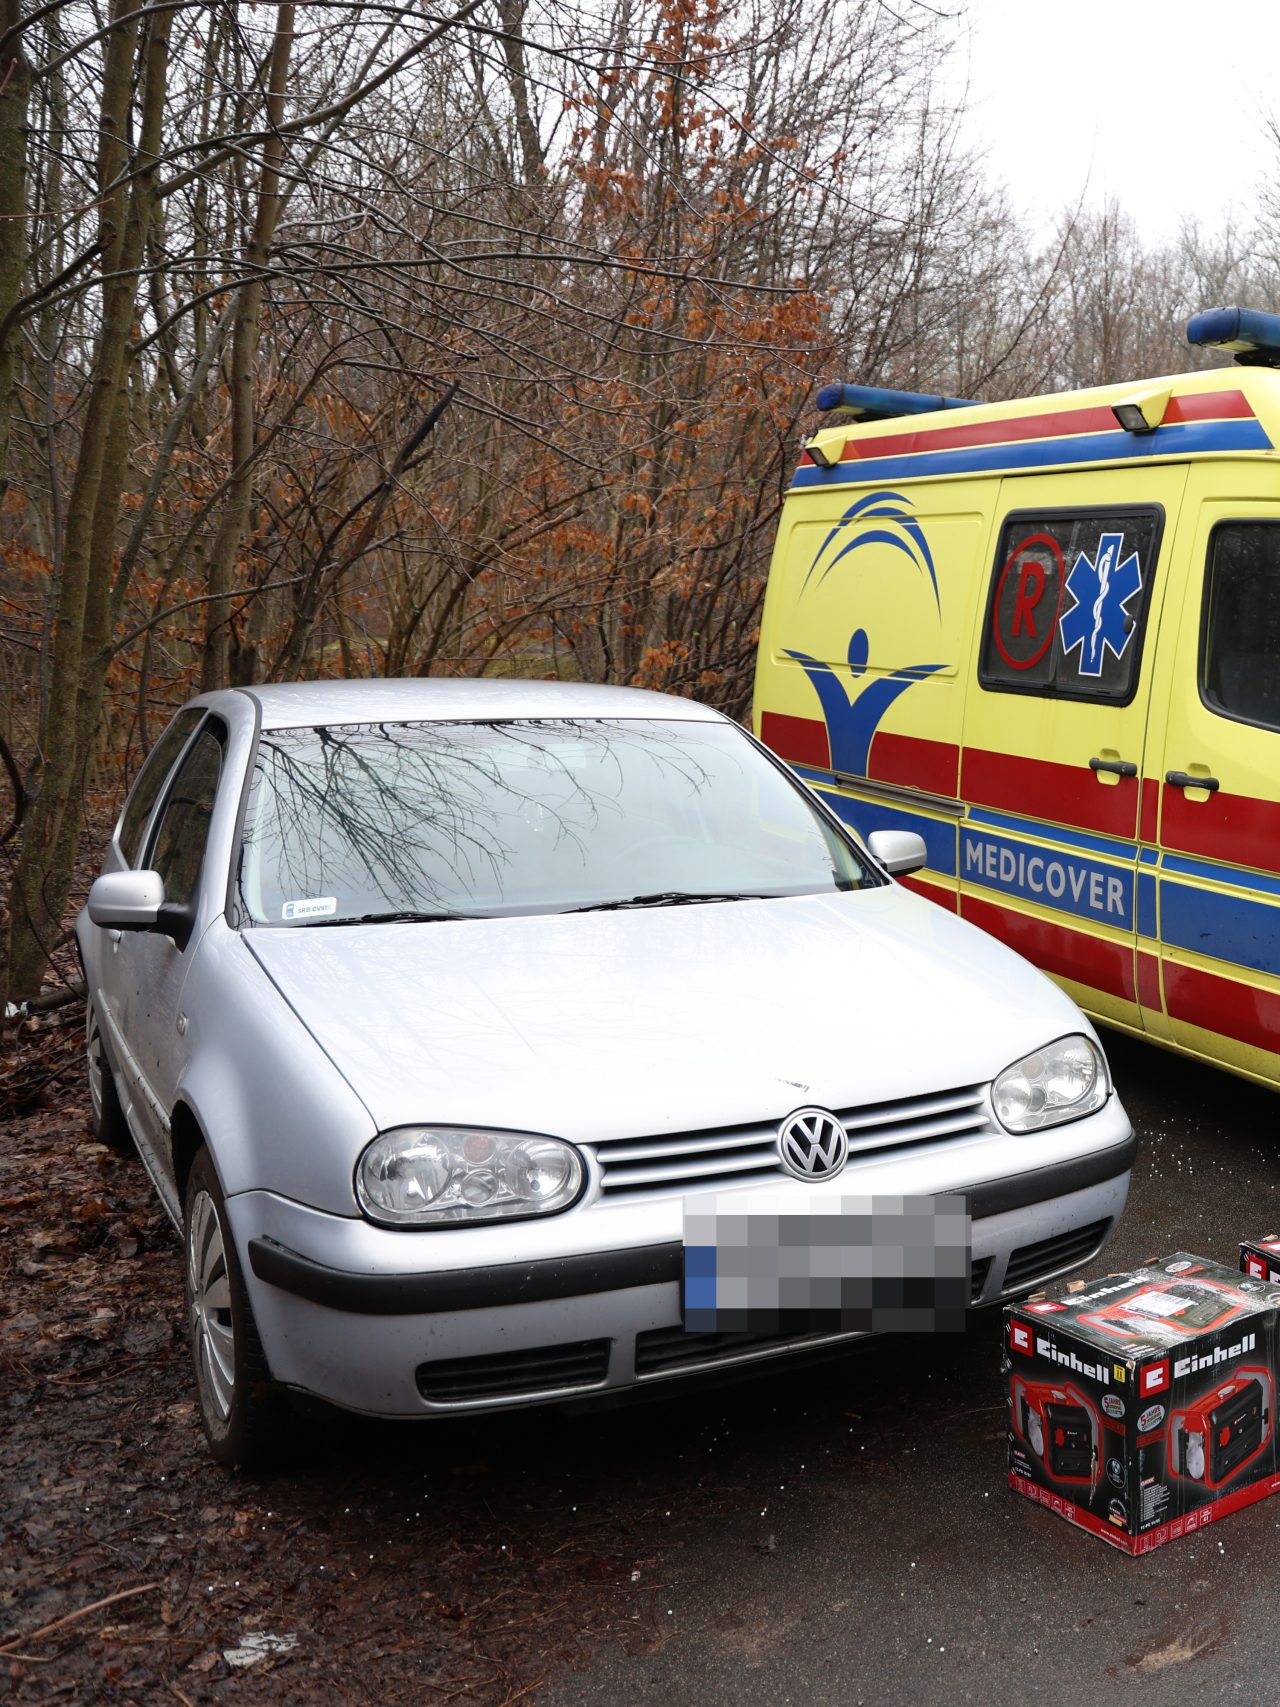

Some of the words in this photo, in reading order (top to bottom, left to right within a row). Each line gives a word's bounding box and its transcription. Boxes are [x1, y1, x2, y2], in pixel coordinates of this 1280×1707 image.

[1011, 561, 1045, 638] R
[965, 838, 1126, 917] MEDICOVER
[1060, 1275, 1149, 1306] Einhell
[1036, 1337, 1110, 1385] Einhell
[1174, 1332, 1256, 1379] Einhell
